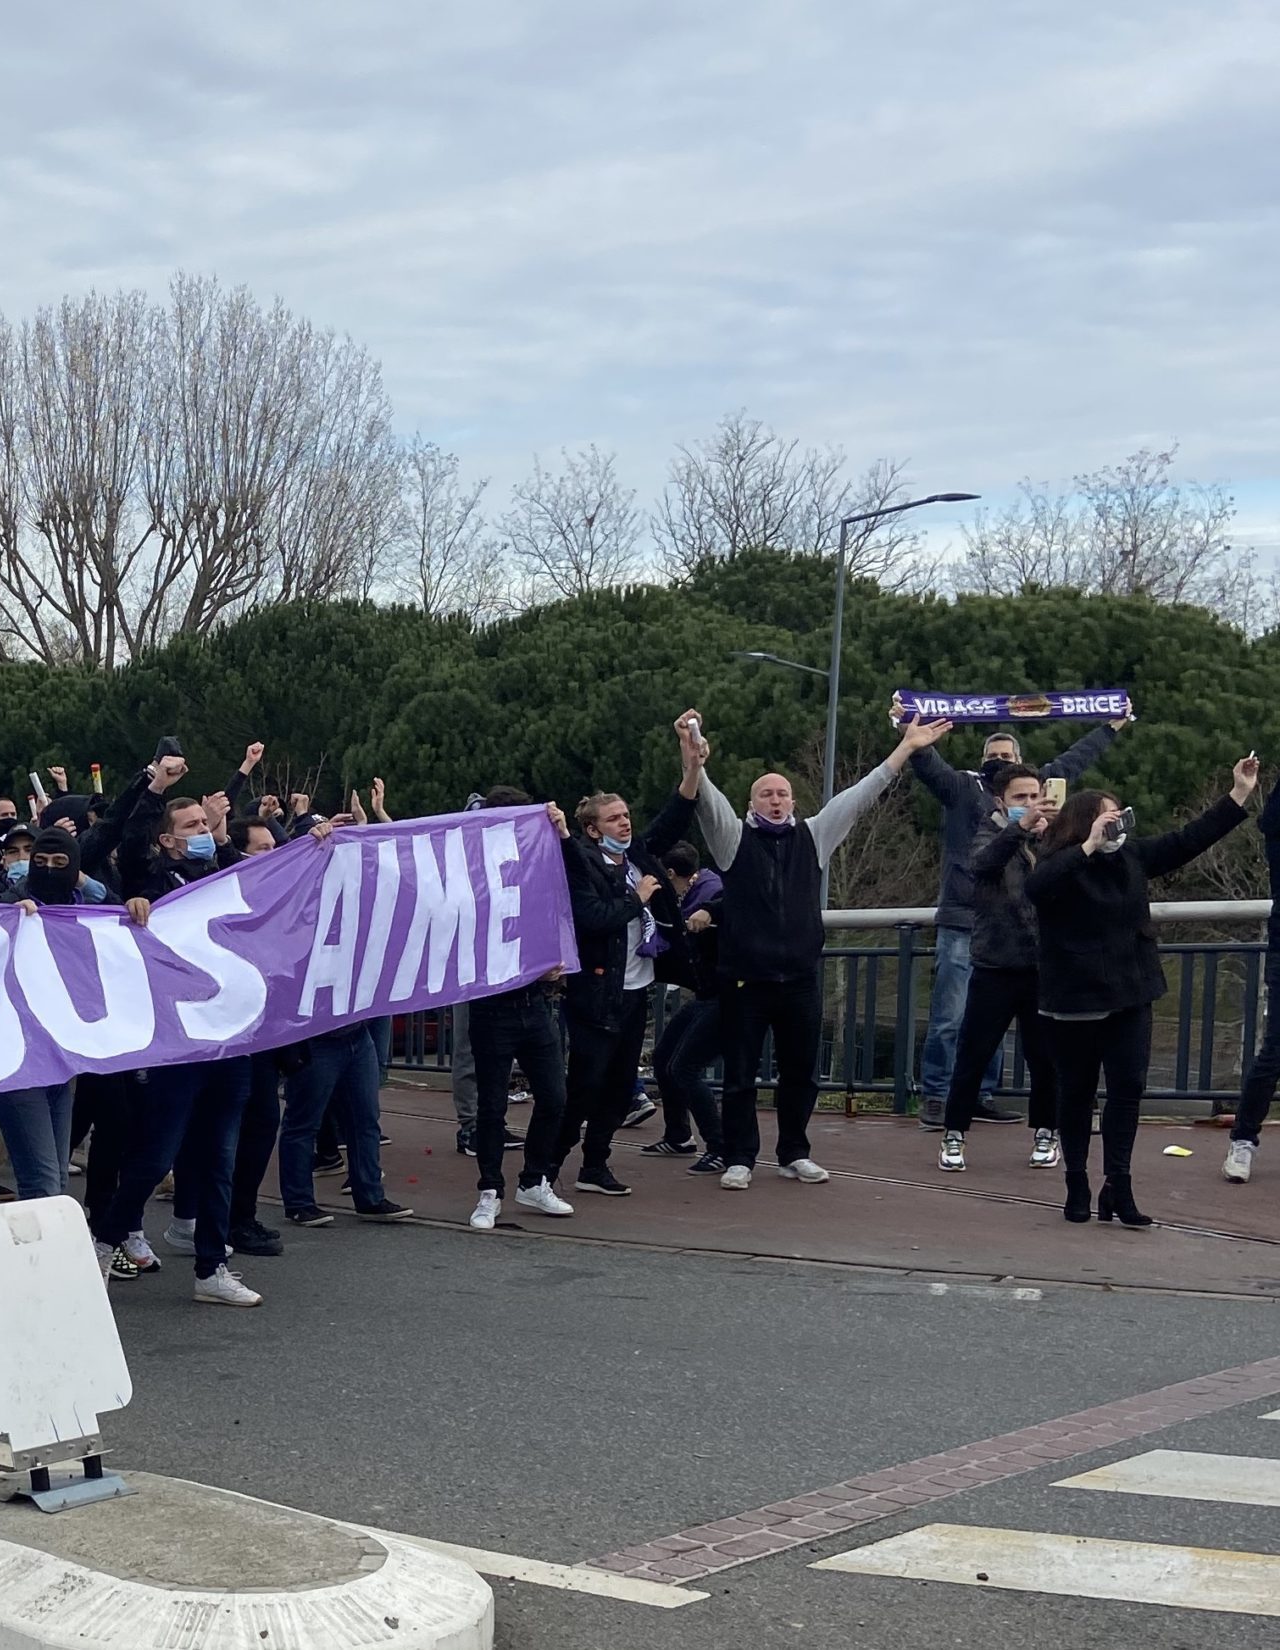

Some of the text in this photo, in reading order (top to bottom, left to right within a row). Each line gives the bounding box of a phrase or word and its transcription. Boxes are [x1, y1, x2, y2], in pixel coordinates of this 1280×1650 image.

[914, 694, 1121, 716] VIRAGE BRICE
[298, 822, 522, 1017] AIME
